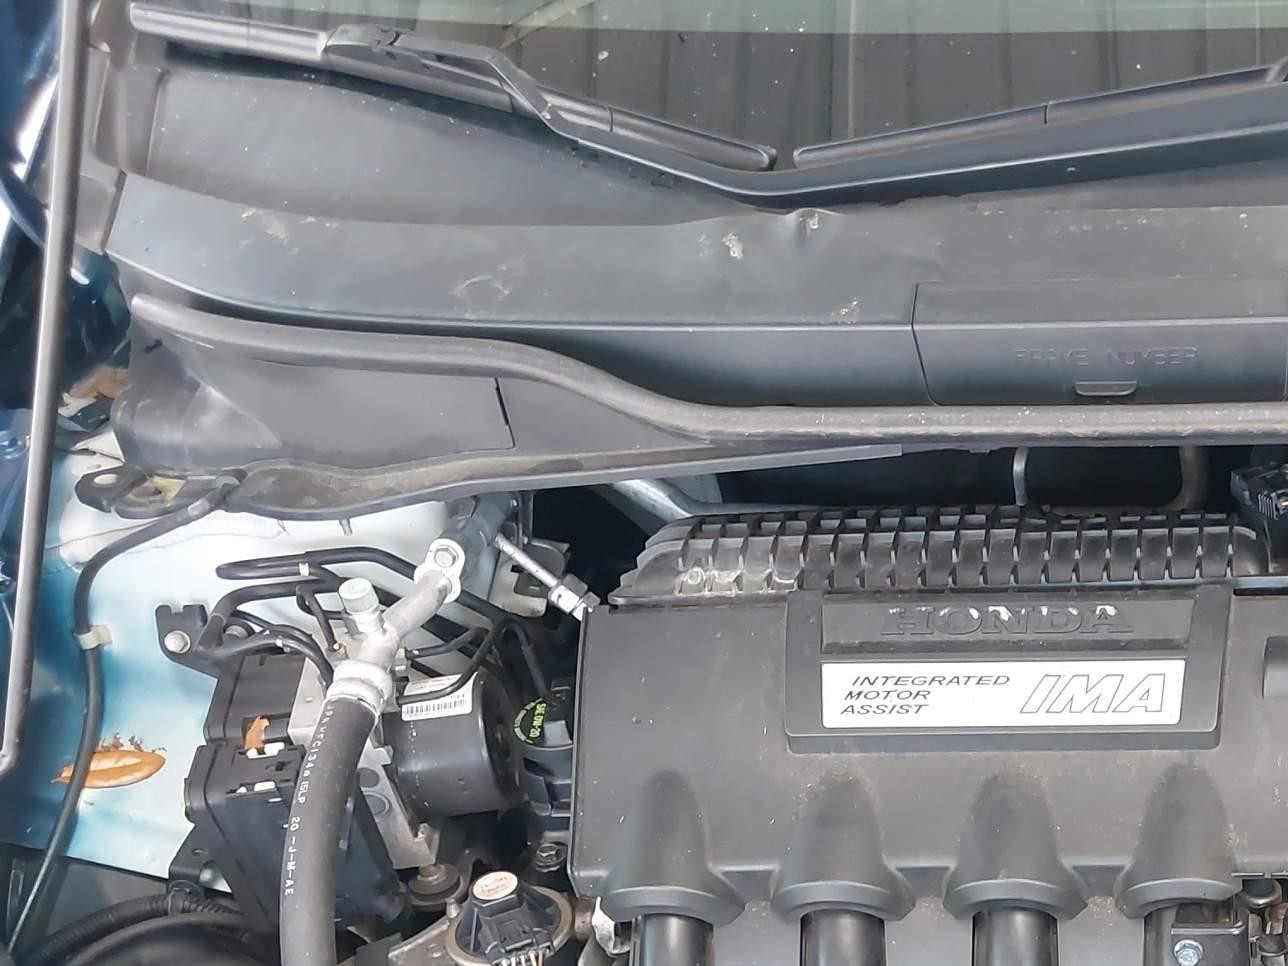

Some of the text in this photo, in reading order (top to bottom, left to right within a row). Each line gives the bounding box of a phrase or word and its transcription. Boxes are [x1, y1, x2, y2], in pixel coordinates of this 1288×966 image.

[880, 605, 1135, 636] HONDA
[852, 675, 1011, 687] INTEGRATED
[843, 689, 932, 701] MOTOR
[1019, 673, 1167, 715] IMA
[840, 704, 930, 715] ASSIST
